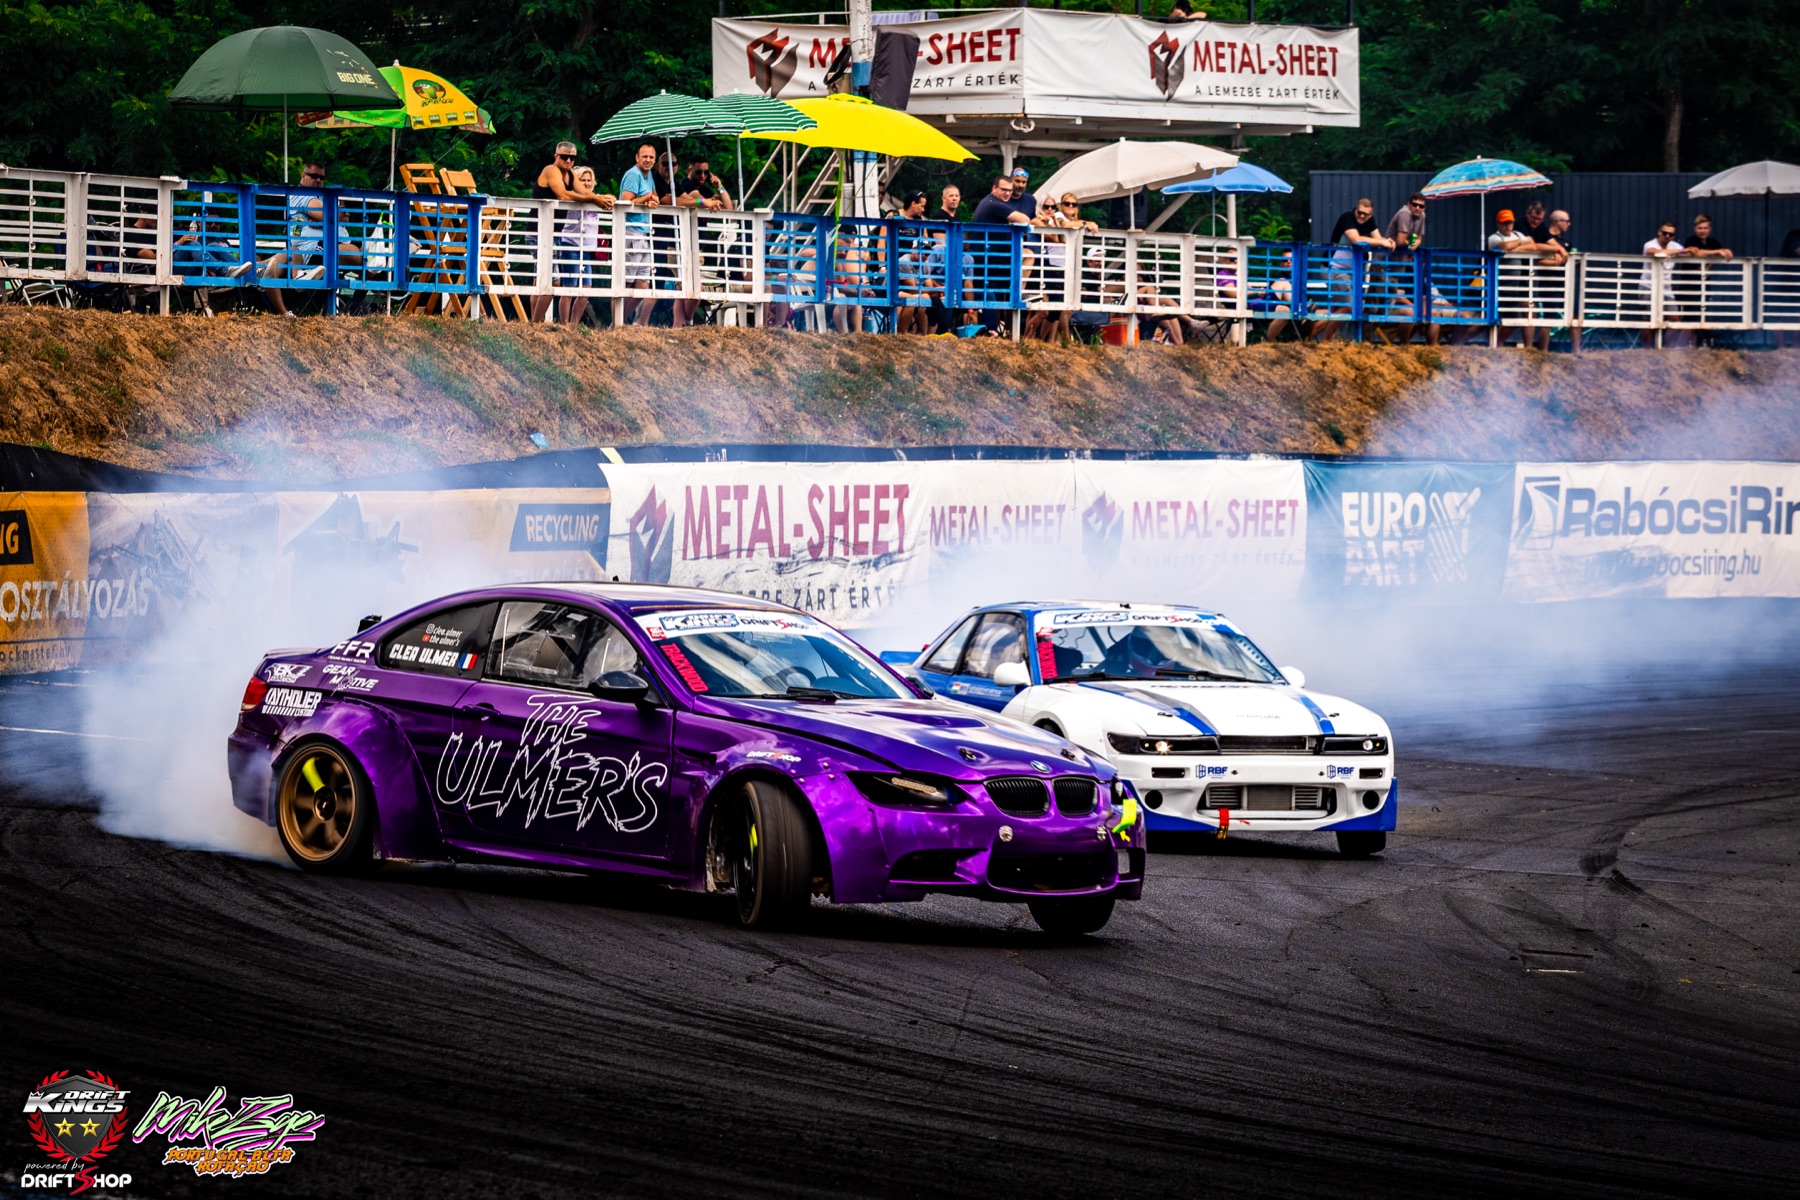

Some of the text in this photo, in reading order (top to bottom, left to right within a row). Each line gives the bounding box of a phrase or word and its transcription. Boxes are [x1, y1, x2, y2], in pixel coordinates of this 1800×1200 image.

[808, 27, 1021, 69] M-SHEET
[1193, 40, 1338, 77] METAL-SHEET
[337, 71, 376, 86] BIG ONE
[911, 75, 955, 89] ZÁRT
[964, 73, 1019, 87] ÉRTÉK
[1195, 85, 1340, 100] A LEMEZBE ZÁRT ÉRTÉK
[525, 514, 600, 543] RECYCLING
[682, 483, 910, 560] METAL-SHEET
[930, 503, 1067, 546] METAL-SHEET
[1131, 499, 1300, 541] METAL-SHEET
[1341, 491, 1427, 538] EURO
[0, 521, 19, 555] G
[1255, 546, 1296, 567] ÉRTÉK
[1344, 539, 1425, 586] PART
[0, 569, 150, 623] OSZTÁLYOZÁS
[793, 581, 837, 611] ZÁRT
[849, 578, 899, 609] ÉRTÉ
[331, 640, 376, 659] FFR
[418, 647, 460, 667] ULMER
[322, 664, 357, 676] GEAR
[521, 694, 602, 746] THE
[436, 732, 668, 833] ULMER'S
[1207, 766, 1228, 775] RBF
[1337, 767, 1355, 775] RBF
